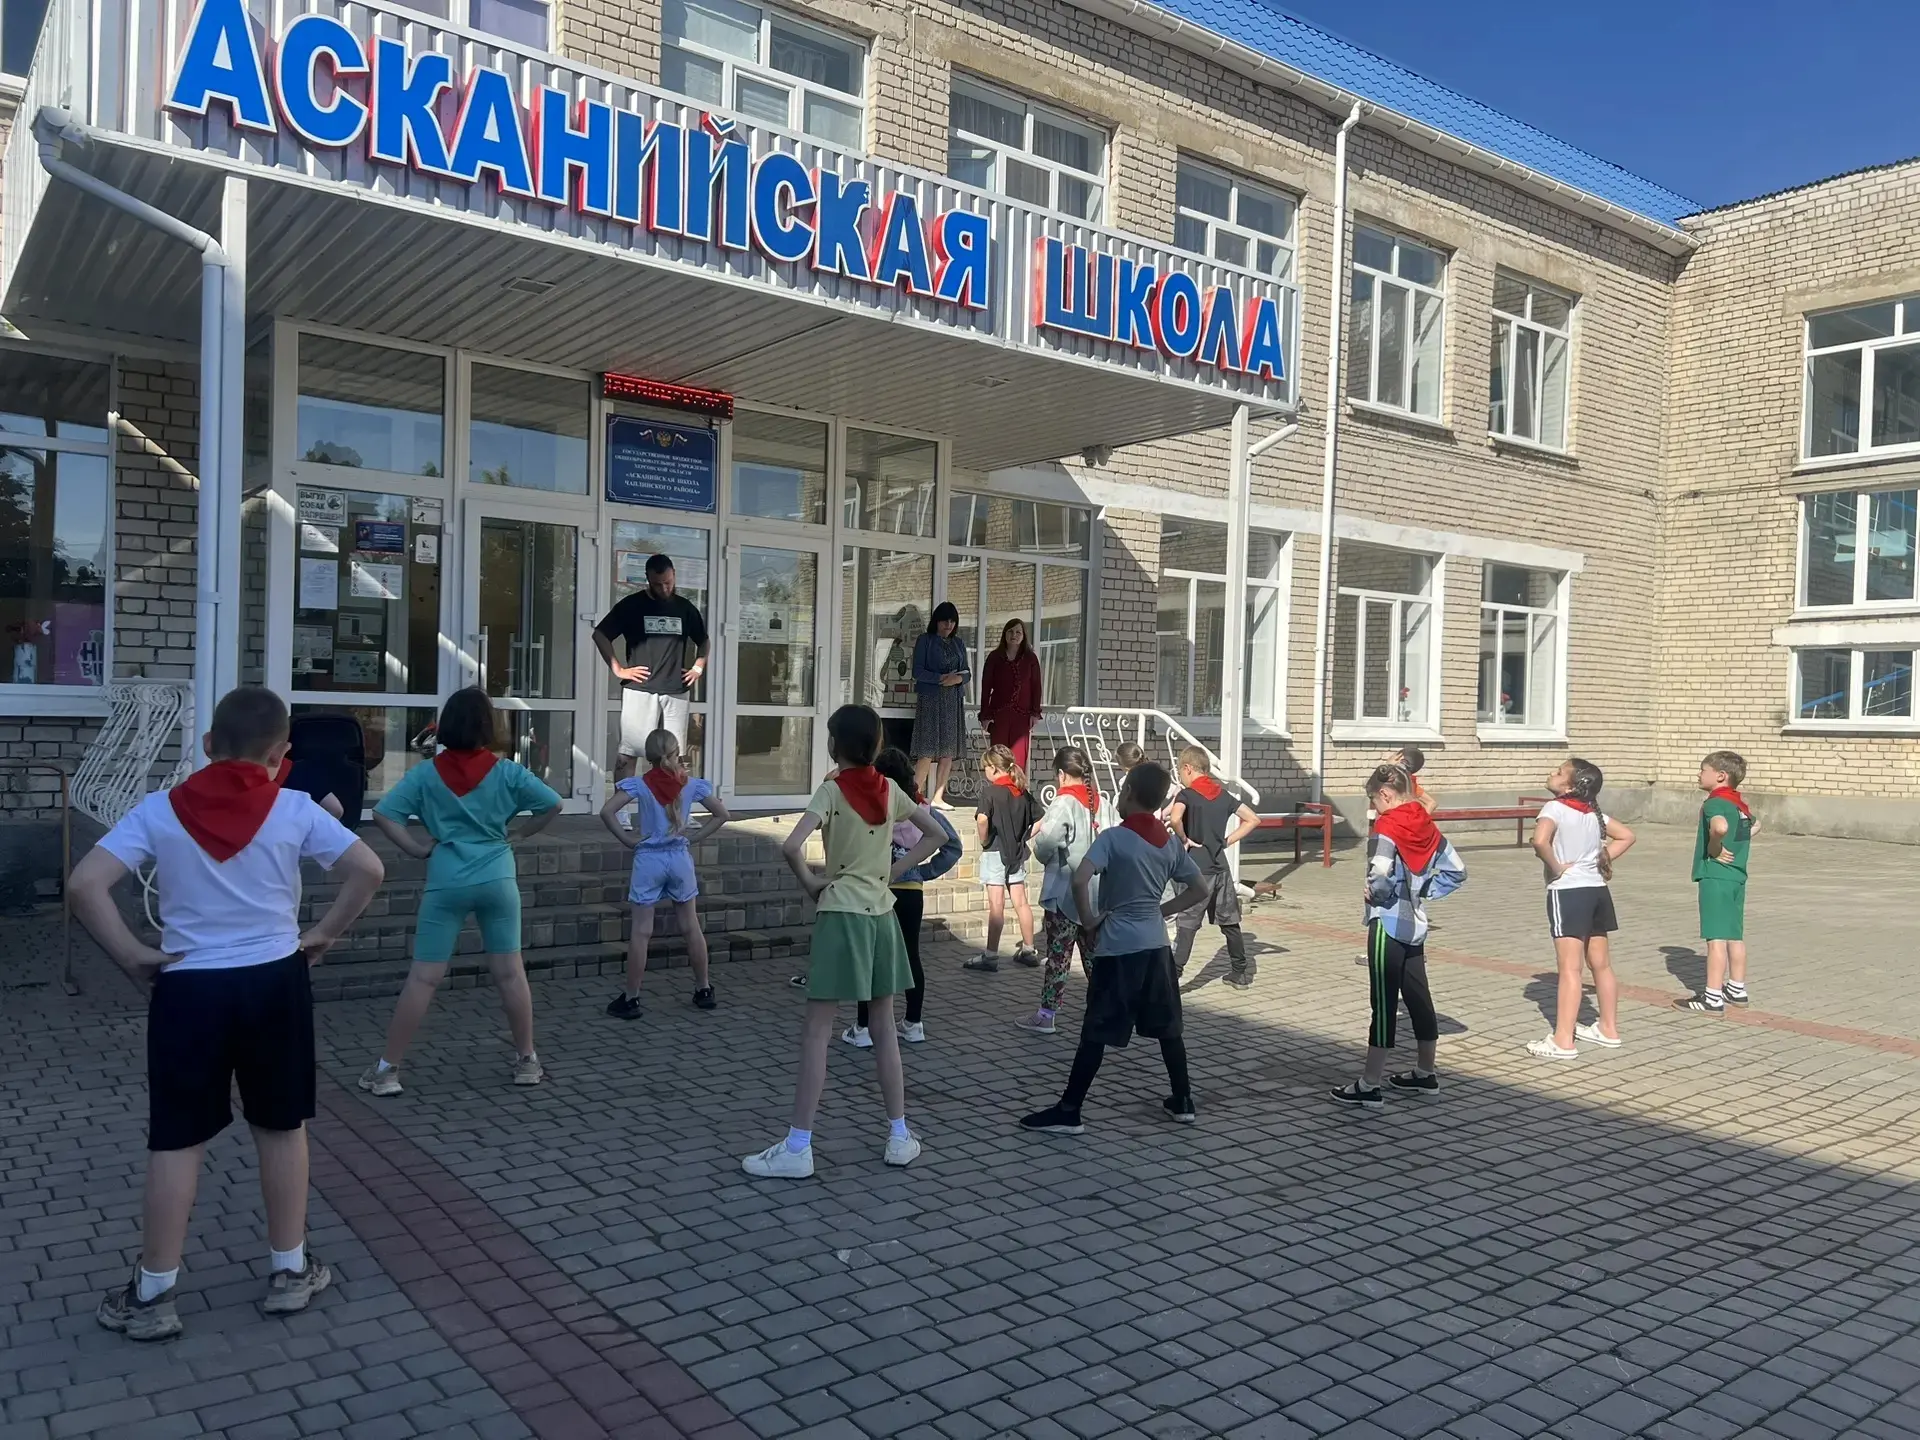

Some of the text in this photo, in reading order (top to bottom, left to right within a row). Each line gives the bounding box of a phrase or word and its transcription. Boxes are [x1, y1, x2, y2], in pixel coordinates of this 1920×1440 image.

[163, 0, 1287, 381] АСКАНИЙСКАЯ ШКОЛА
[614, 454, 709, 471] ОБЩЕОБРАЗОВАТЕЛЬНОЕ УЧРЕЖДЕНИЕ
[622, 449, 703, 464] ГОСУДАРСТВЕННОЕ БЮДЖЕТНОЕ
[634, 463, 668, 472] ХЕРСОНСКОЙ
[625, 472, 700, 486] «АСКАНИЙСКАЯ ШКОЛА
[624, 480, 700, 494] ЧАПЛИНСКОГО РАЙОНА»
[300, 491, 326, 500] ВЫГУЛ
[300, 501, 325, 509] СОБАК
